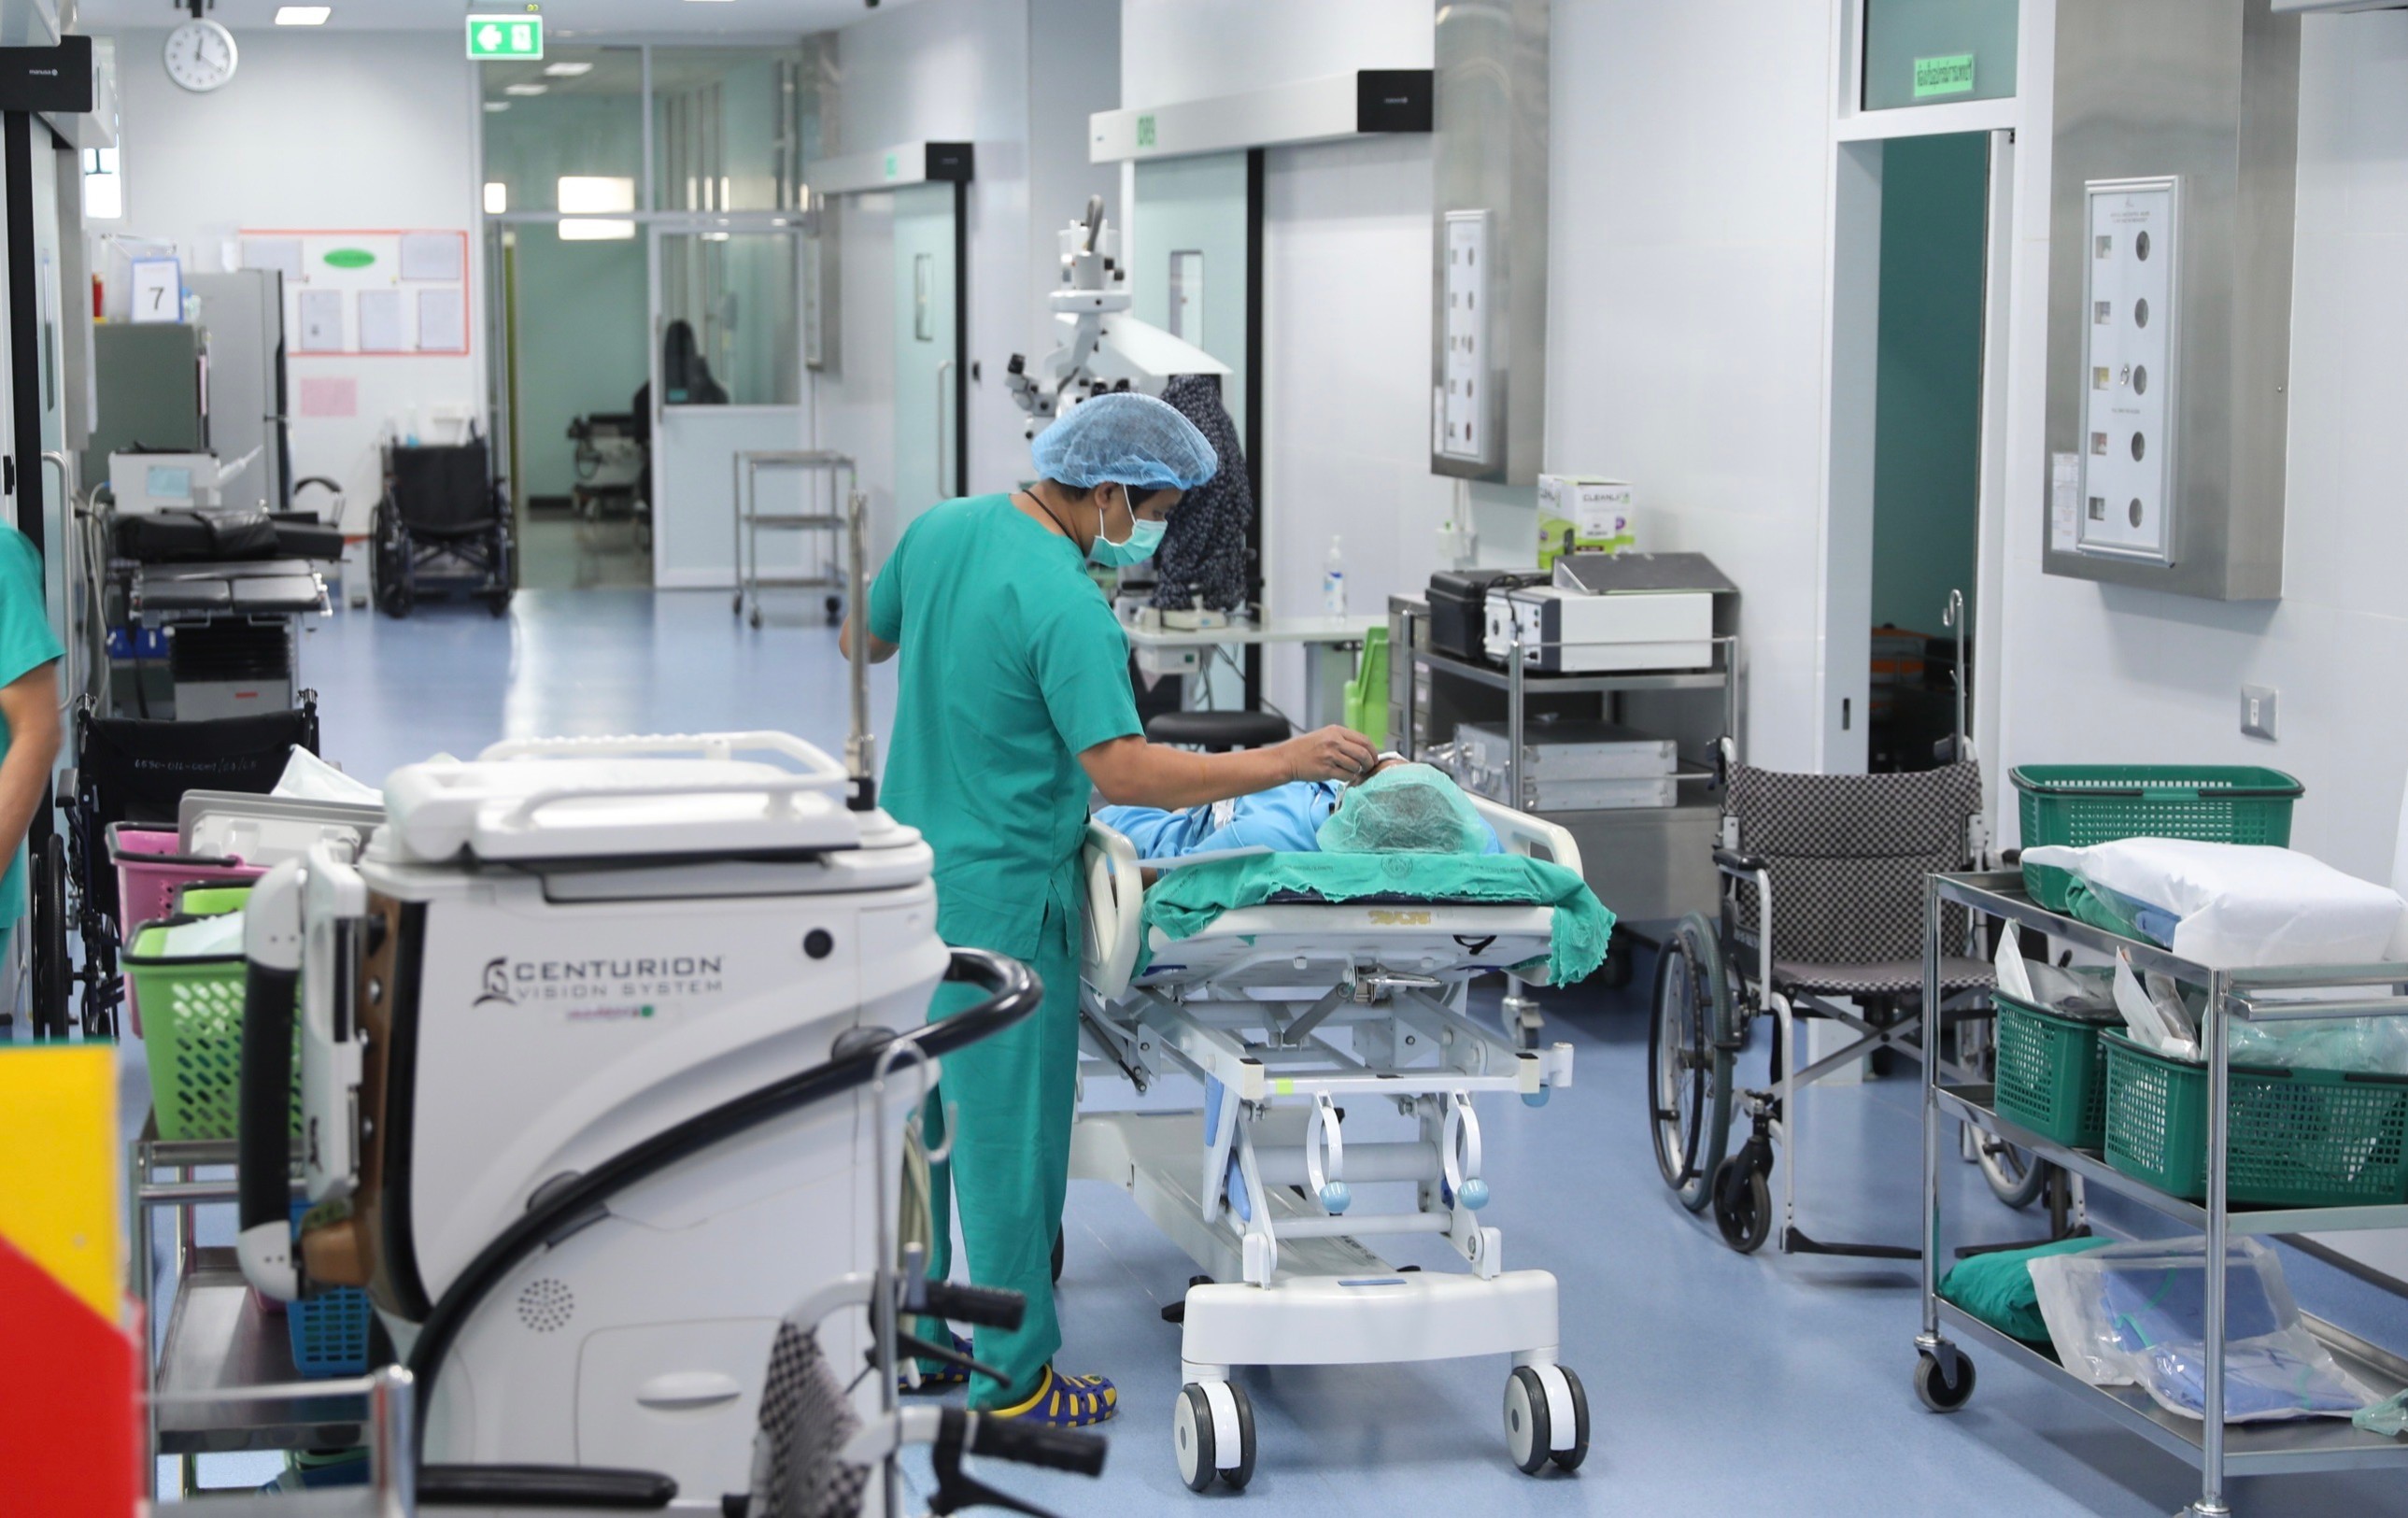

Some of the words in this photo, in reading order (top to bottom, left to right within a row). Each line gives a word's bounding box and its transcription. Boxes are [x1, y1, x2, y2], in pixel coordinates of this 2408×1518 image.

[149, 287, 164, 310] 7
[514, 956, 722, 982] CENTURION
[516, 983, 608, 1000] VISION
[622, 980, 723, 997] SYSTEM
